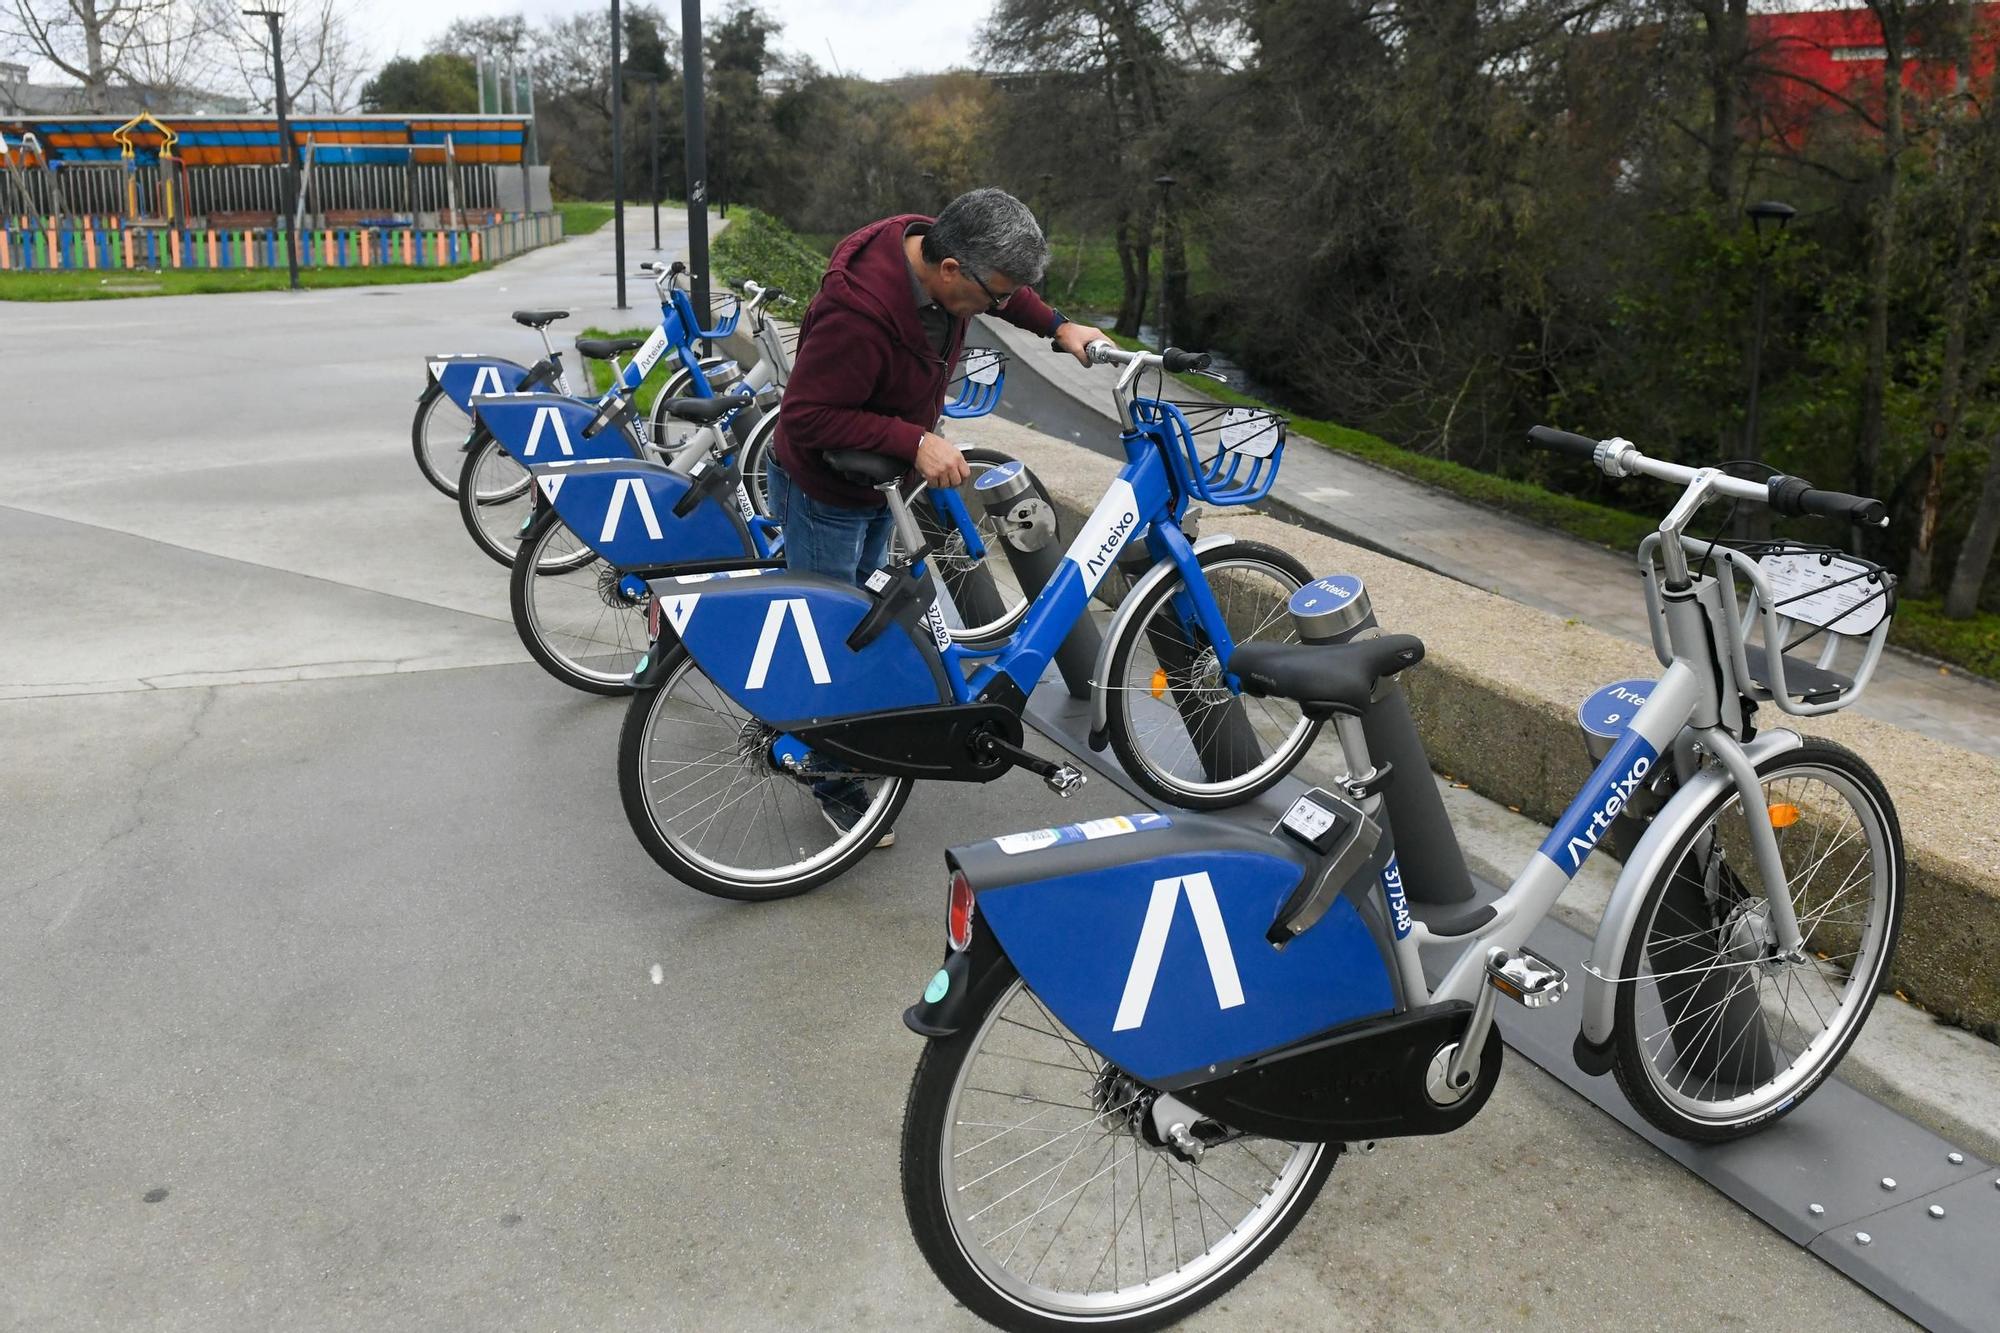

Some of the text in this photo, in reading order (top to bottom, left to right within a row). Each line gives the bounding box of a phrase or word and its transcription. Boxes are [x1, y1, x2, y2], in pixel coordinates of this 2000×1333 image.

[1086, 511, 1134, 577] Arteixo
[928, 604, 951, 647] 372492
[1603, 713, 1620, 724] 9
[1608, 687, 1646, 706] Arte
[1567, 756, 1650, 868] Arteixo
[1384, 865, 1412, 932] 377548
